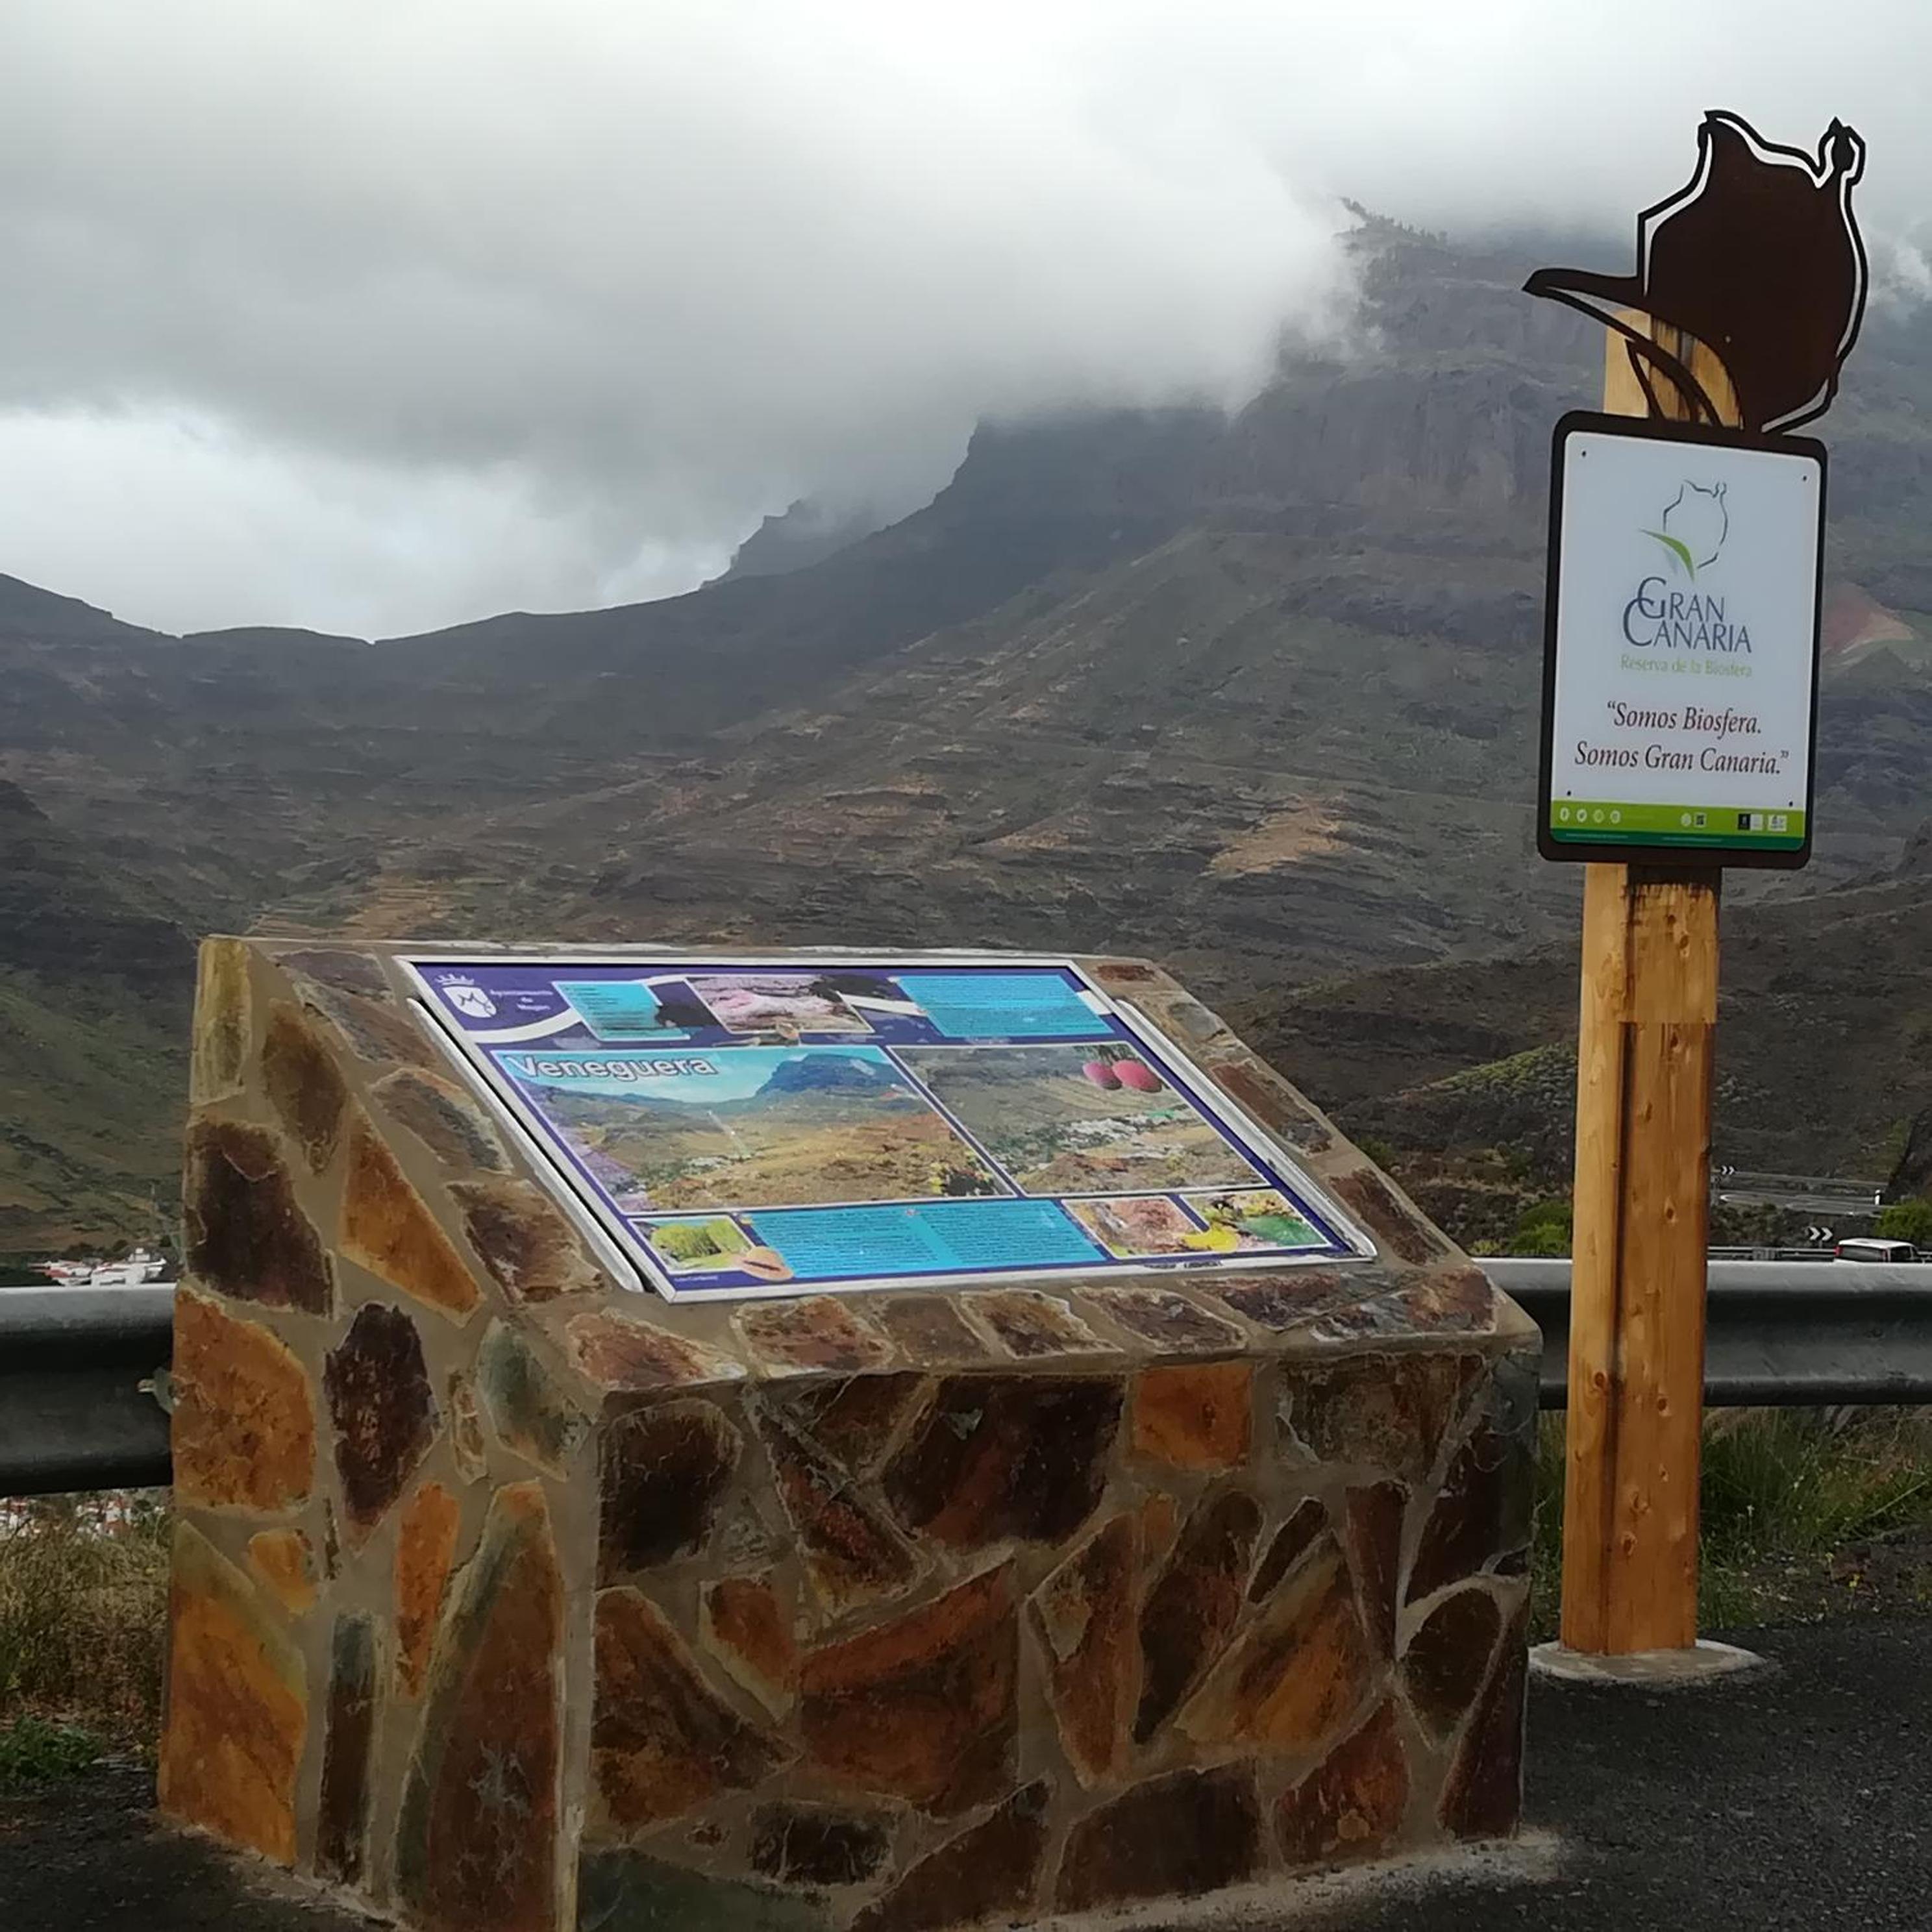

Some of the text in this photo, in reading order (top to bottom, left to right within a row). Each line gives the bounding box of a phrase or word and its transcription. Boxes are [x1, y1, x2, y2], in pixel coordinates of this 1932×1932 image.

[1637, 576, 1725, 623] GRAN
[1623, 597, 1752, 654] CANARIA
[1620, 654, 1669, 671] Reserva
[1672, 657, 1687, 673] de
[1704, 660, 1753, 678] Biosfera
[1682, 706, 1762, 739] Biosfera.
[1574, 740, 1639, 767] Somos
[1644, 744, 1694, 771] Gran
[502, 1054, 719, 1082] Veneguera
